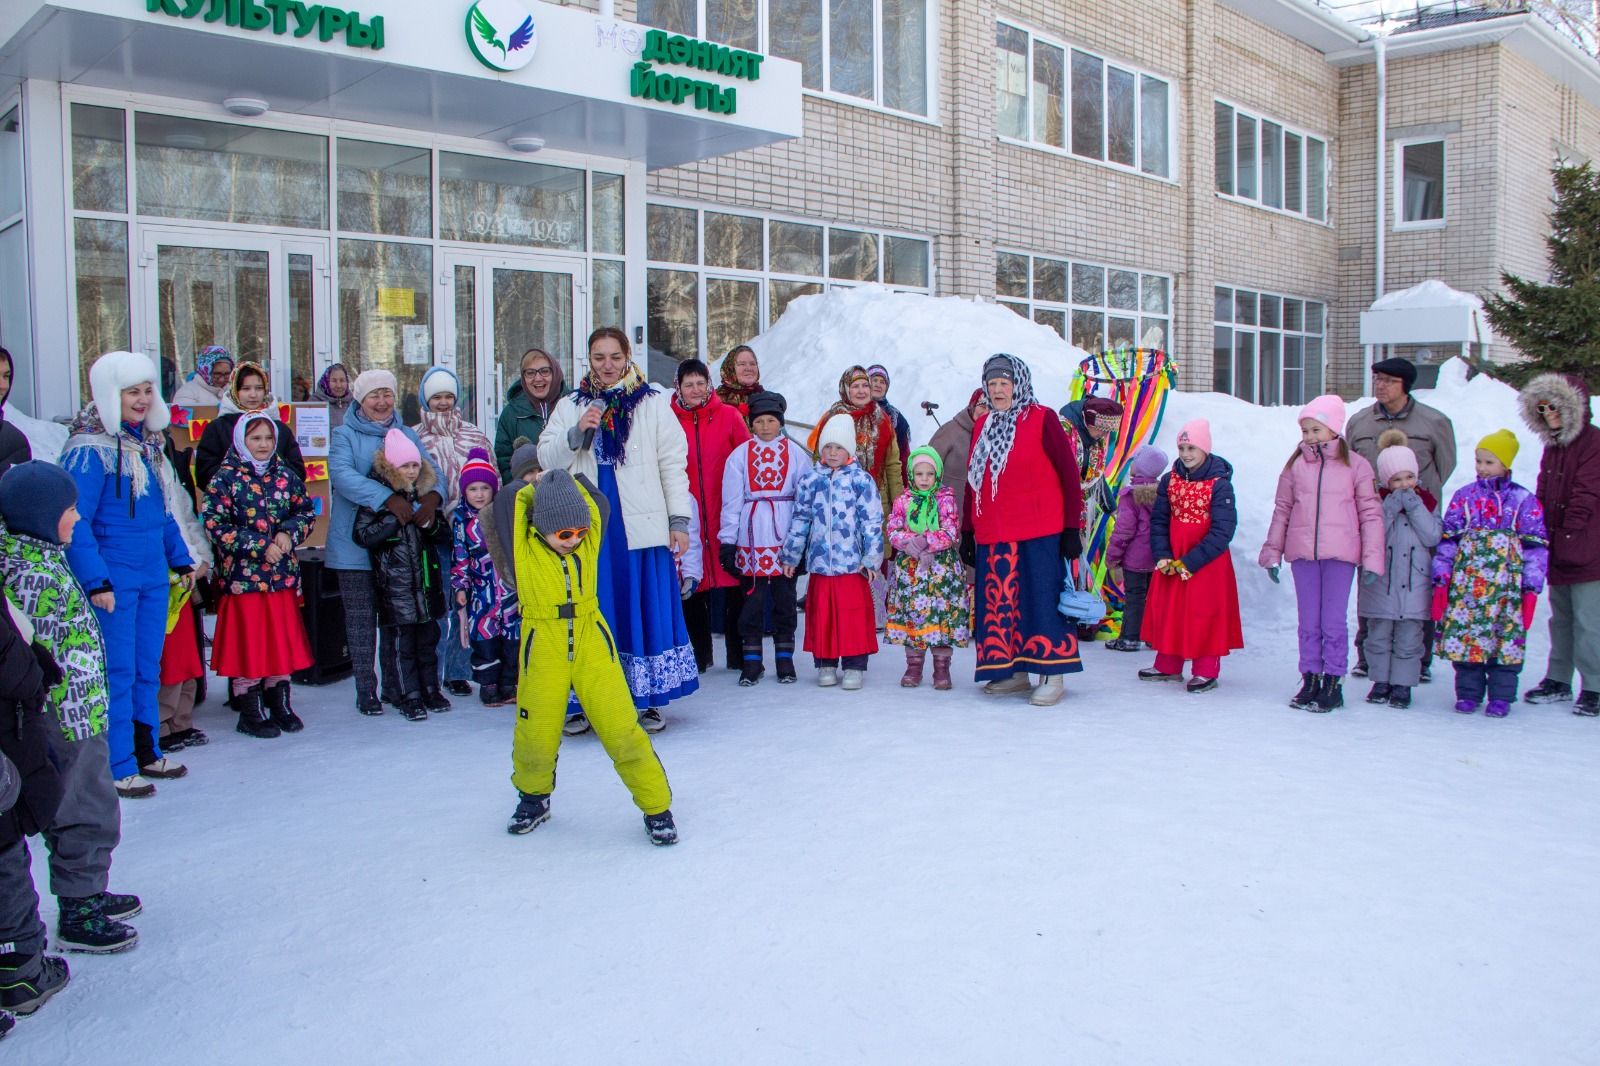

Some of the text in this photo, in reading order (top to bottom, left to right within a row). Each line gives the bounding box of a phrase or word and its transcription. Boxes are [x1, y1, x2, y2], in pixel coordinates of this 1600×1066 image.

[630, 61, 737, 115] ЙОРТЫ
[467, 210, 573, 244] 1941 1945
